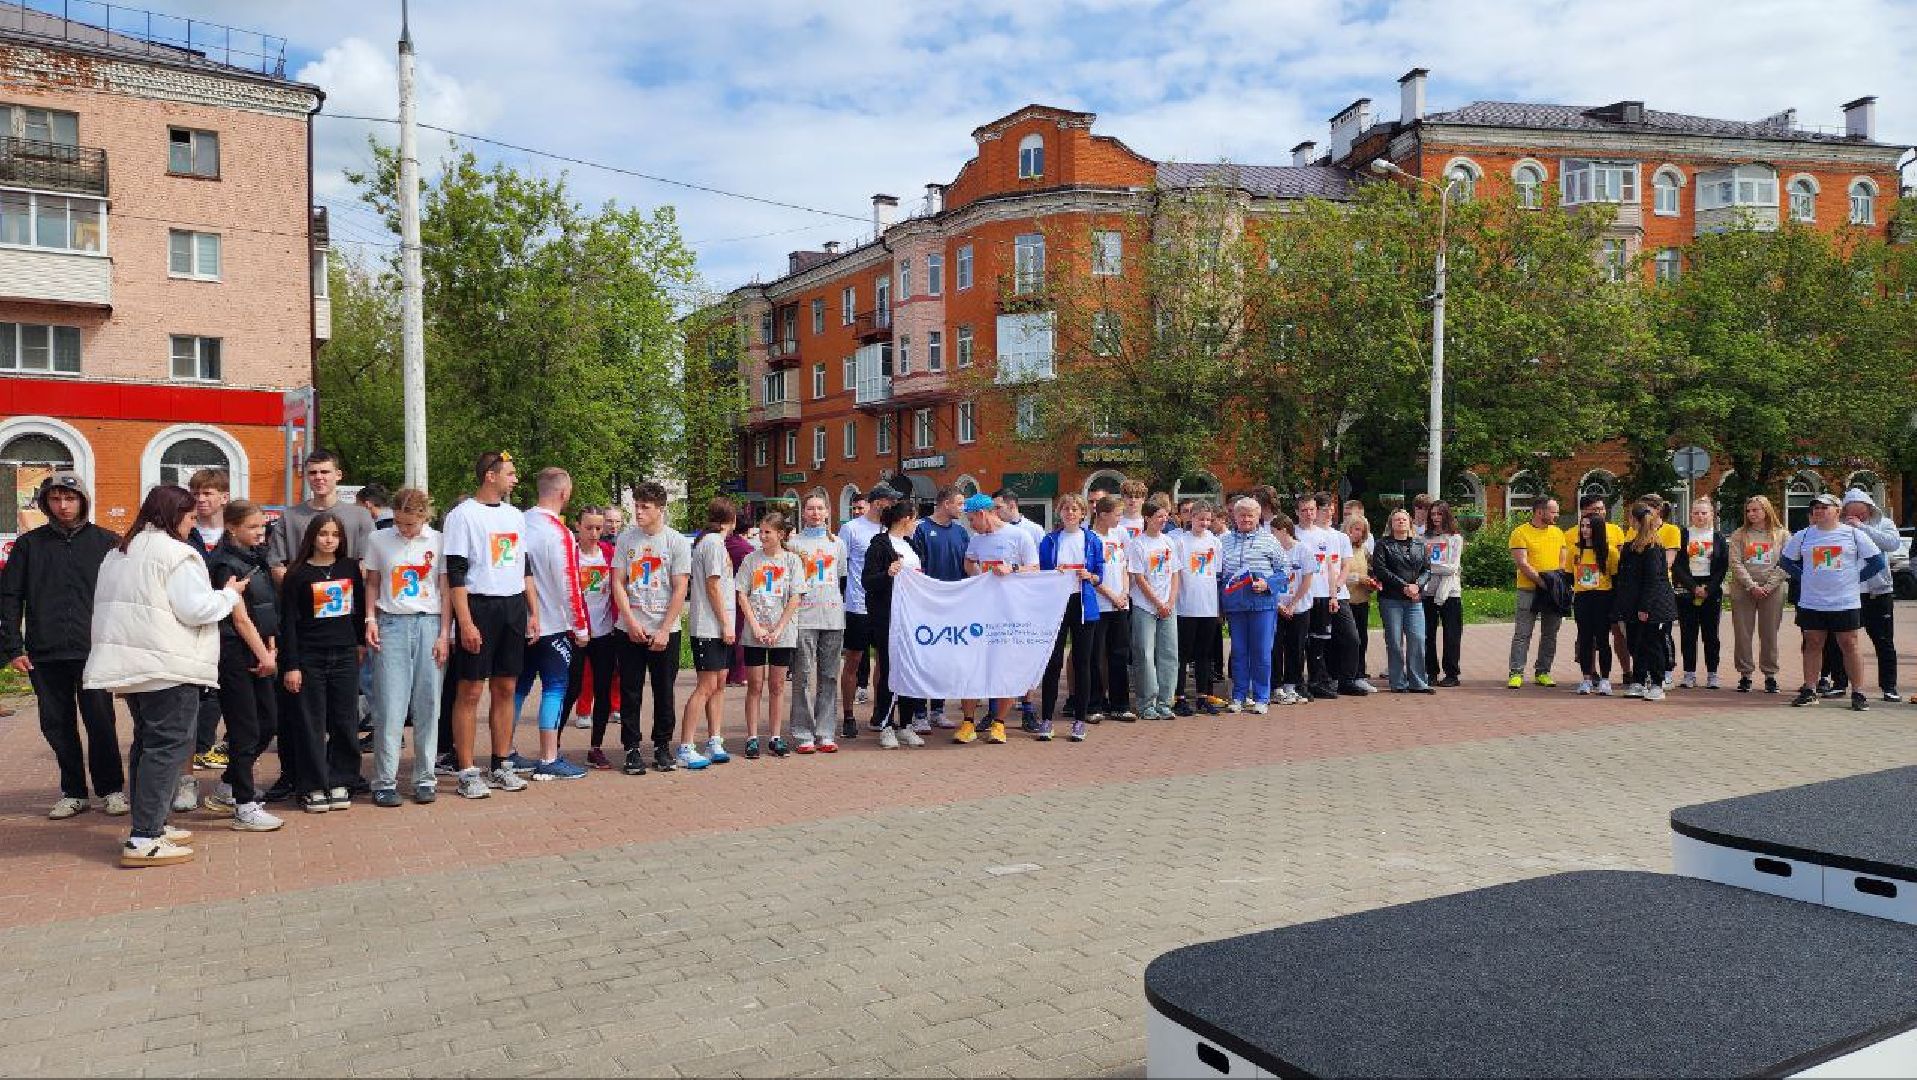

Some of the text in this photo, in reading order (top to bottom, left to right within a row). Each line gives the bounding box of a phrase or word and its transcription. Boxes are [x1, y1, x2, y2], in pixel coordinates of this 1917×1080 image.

[500, 539, 513, 561] 2
[1823, 551, 1832, 567] 1
[642, 561, 650, 585] 1
[815, 560, 824, 581] 1
[403, 569, 419, 597] 3
[589, 571, 602, 592] 2
[765, 571, 773, 592] 1
[325, 586, 343, 612] 3
